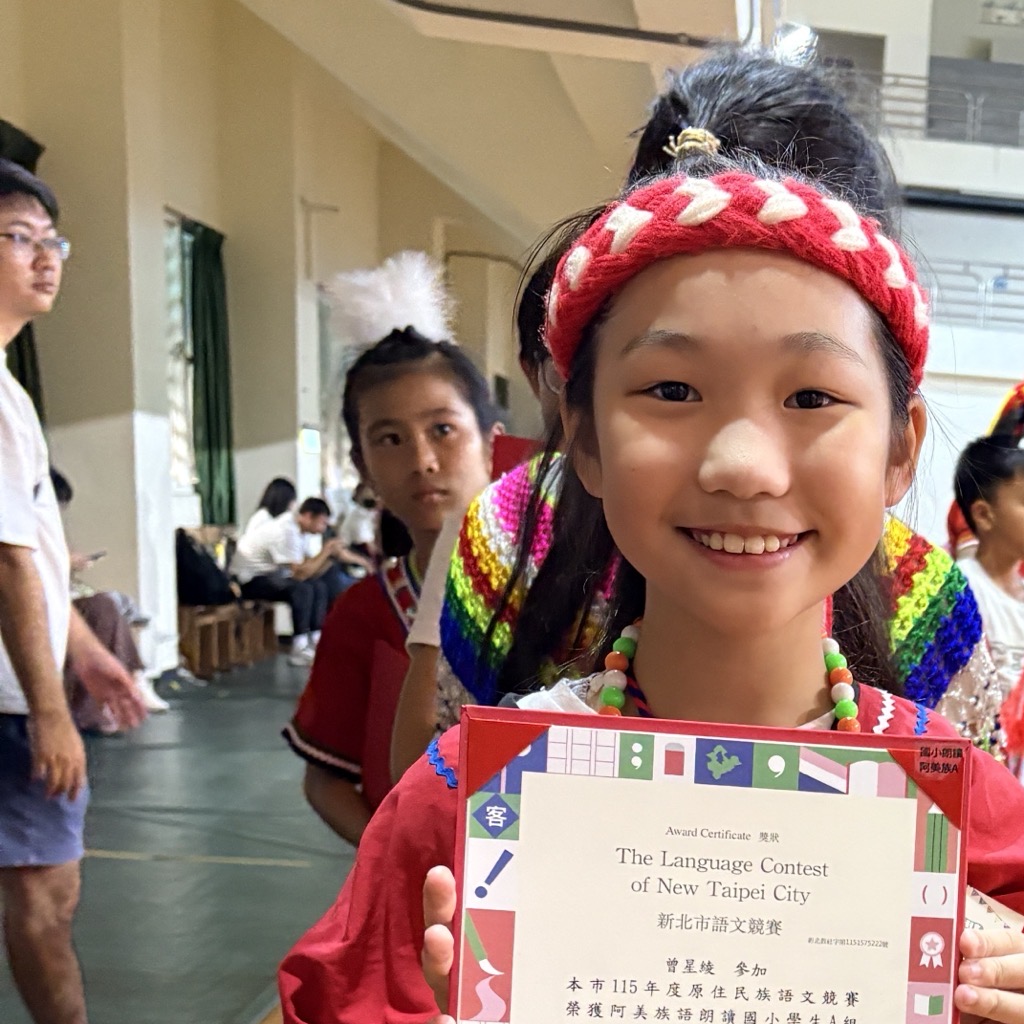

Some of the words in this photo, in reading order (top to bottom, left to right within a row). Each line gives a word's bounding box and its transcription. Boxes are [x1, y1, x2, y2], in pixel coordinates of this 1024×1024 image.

[919, 762, 959, 774] 阿美族A
[485, 805, 508, 827] 客
[666, 826, 698, 838] Award
[700, 828, 752, 841] Certificate
[616, 847, 654, 866] The
[661, 851, 753, 876] Language
[760, 856, 829, 878] Contest
[631, 876, 651, 893] of
[656, 878, 700, 896] New
[707, 880, 766, 903] Taipei
[773, 884, 811, 906] City
[657, 911, 783, 937] 新北市語文競賽
[665, 956, 716, 976] 曾星綾
[734, 960, 768, 978] 參加
